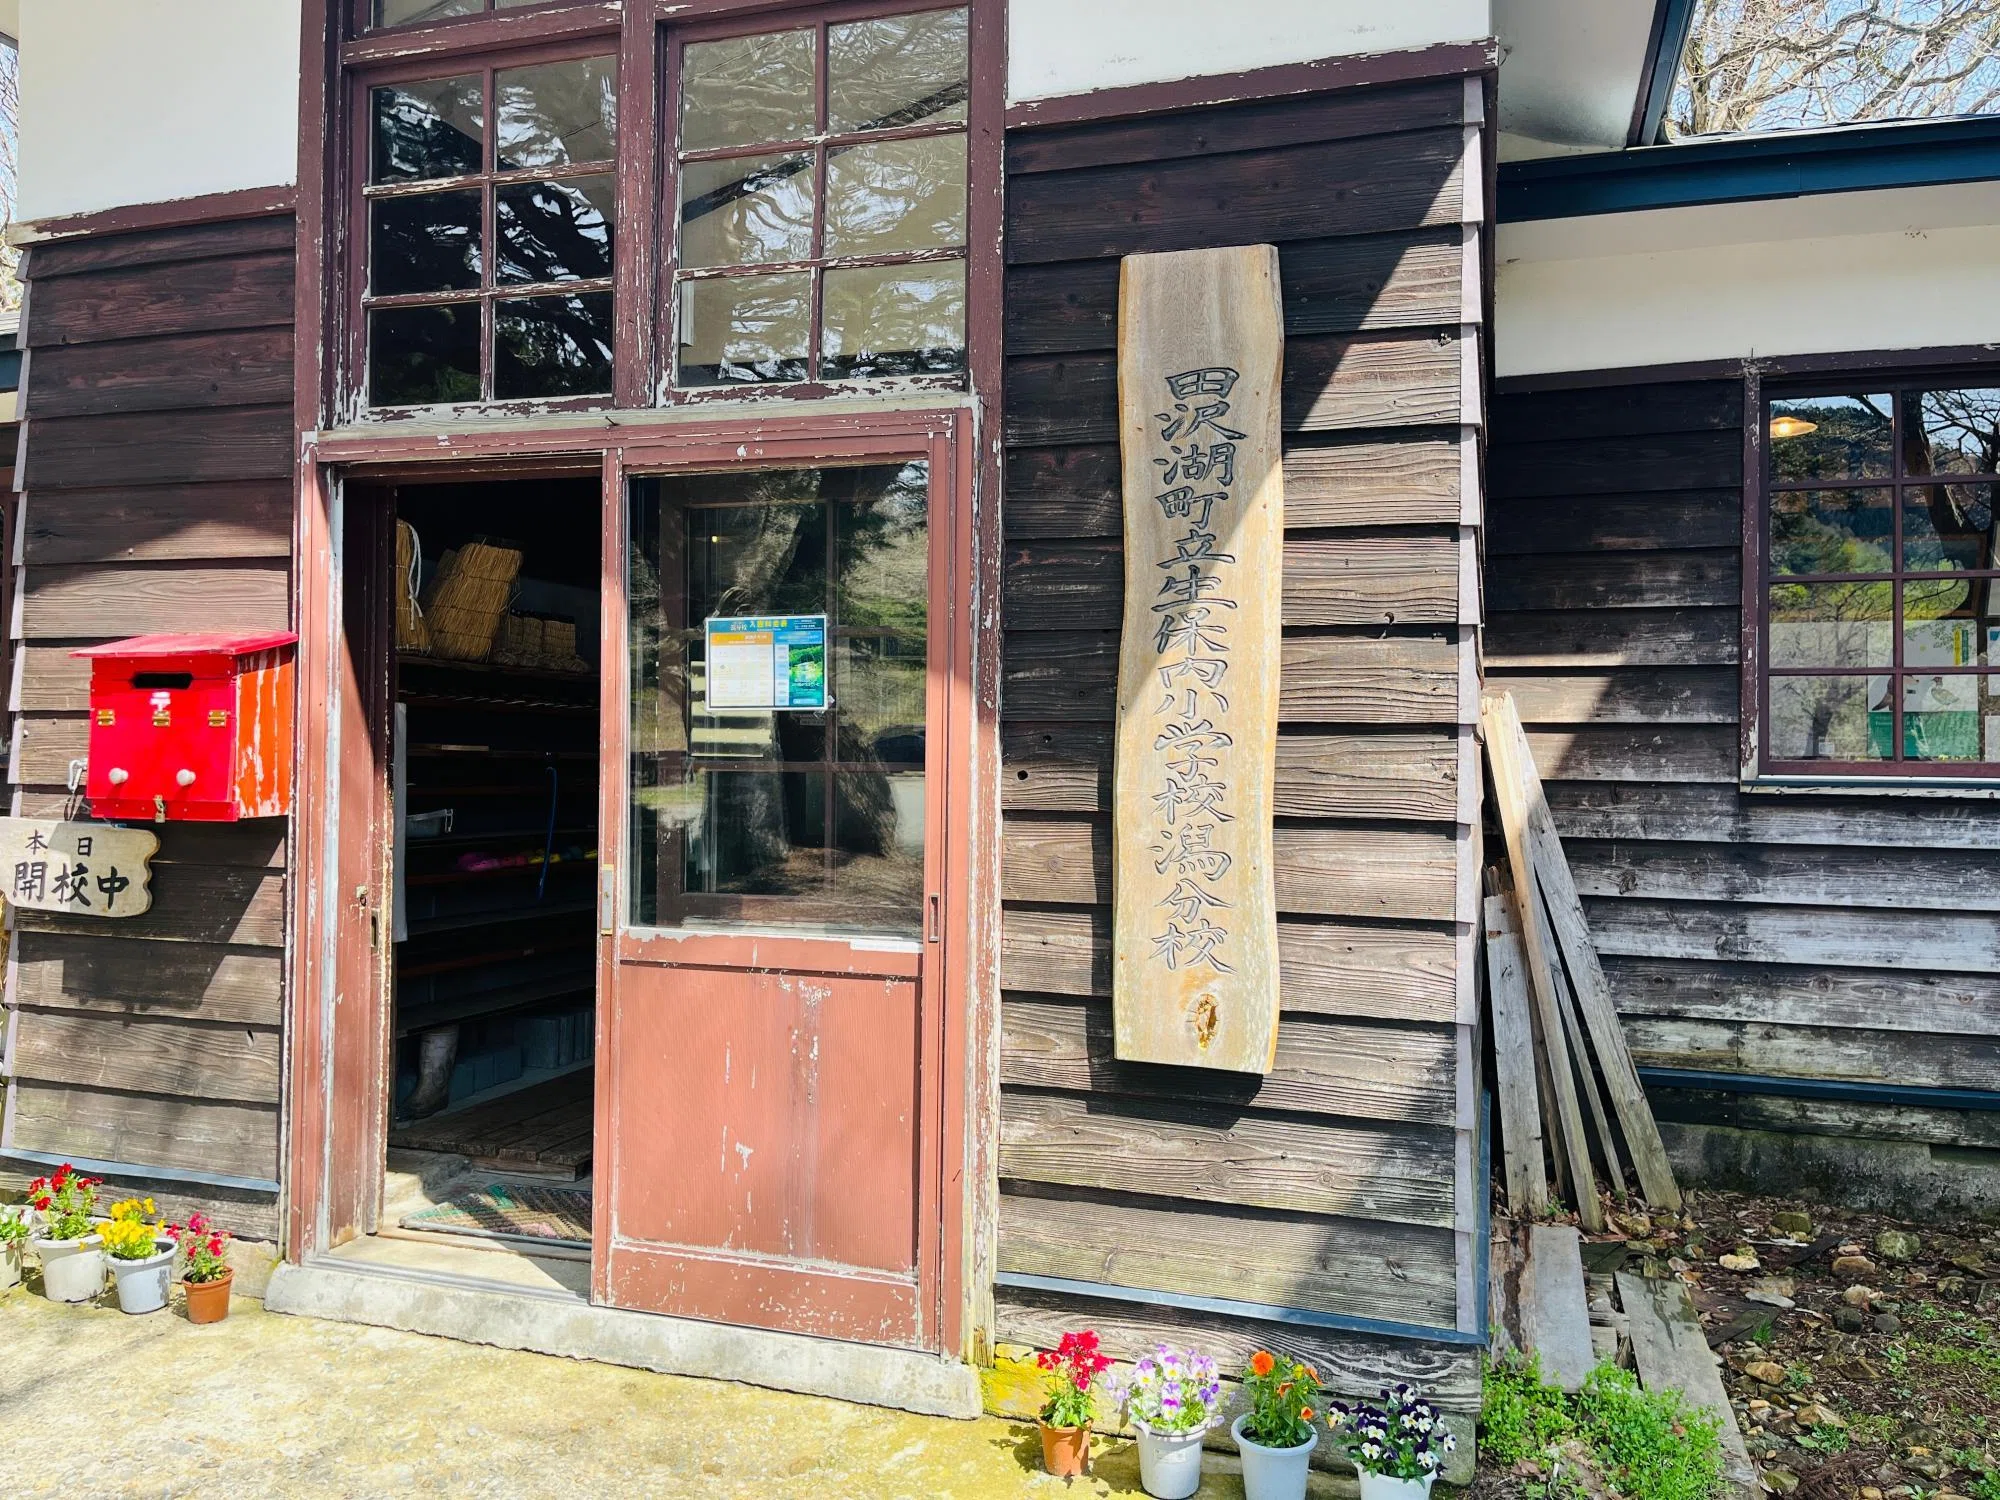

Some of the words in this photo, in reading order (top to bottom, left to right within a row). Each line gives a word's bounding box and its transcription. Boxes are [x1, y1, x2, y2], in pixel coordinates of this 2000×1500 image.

[1146, 367, 1248, 975] 田沢湖町立生保内小学校潟分校
[25, 829, 94, 857] 本日
[12, 860, 130, 910] 開校中
